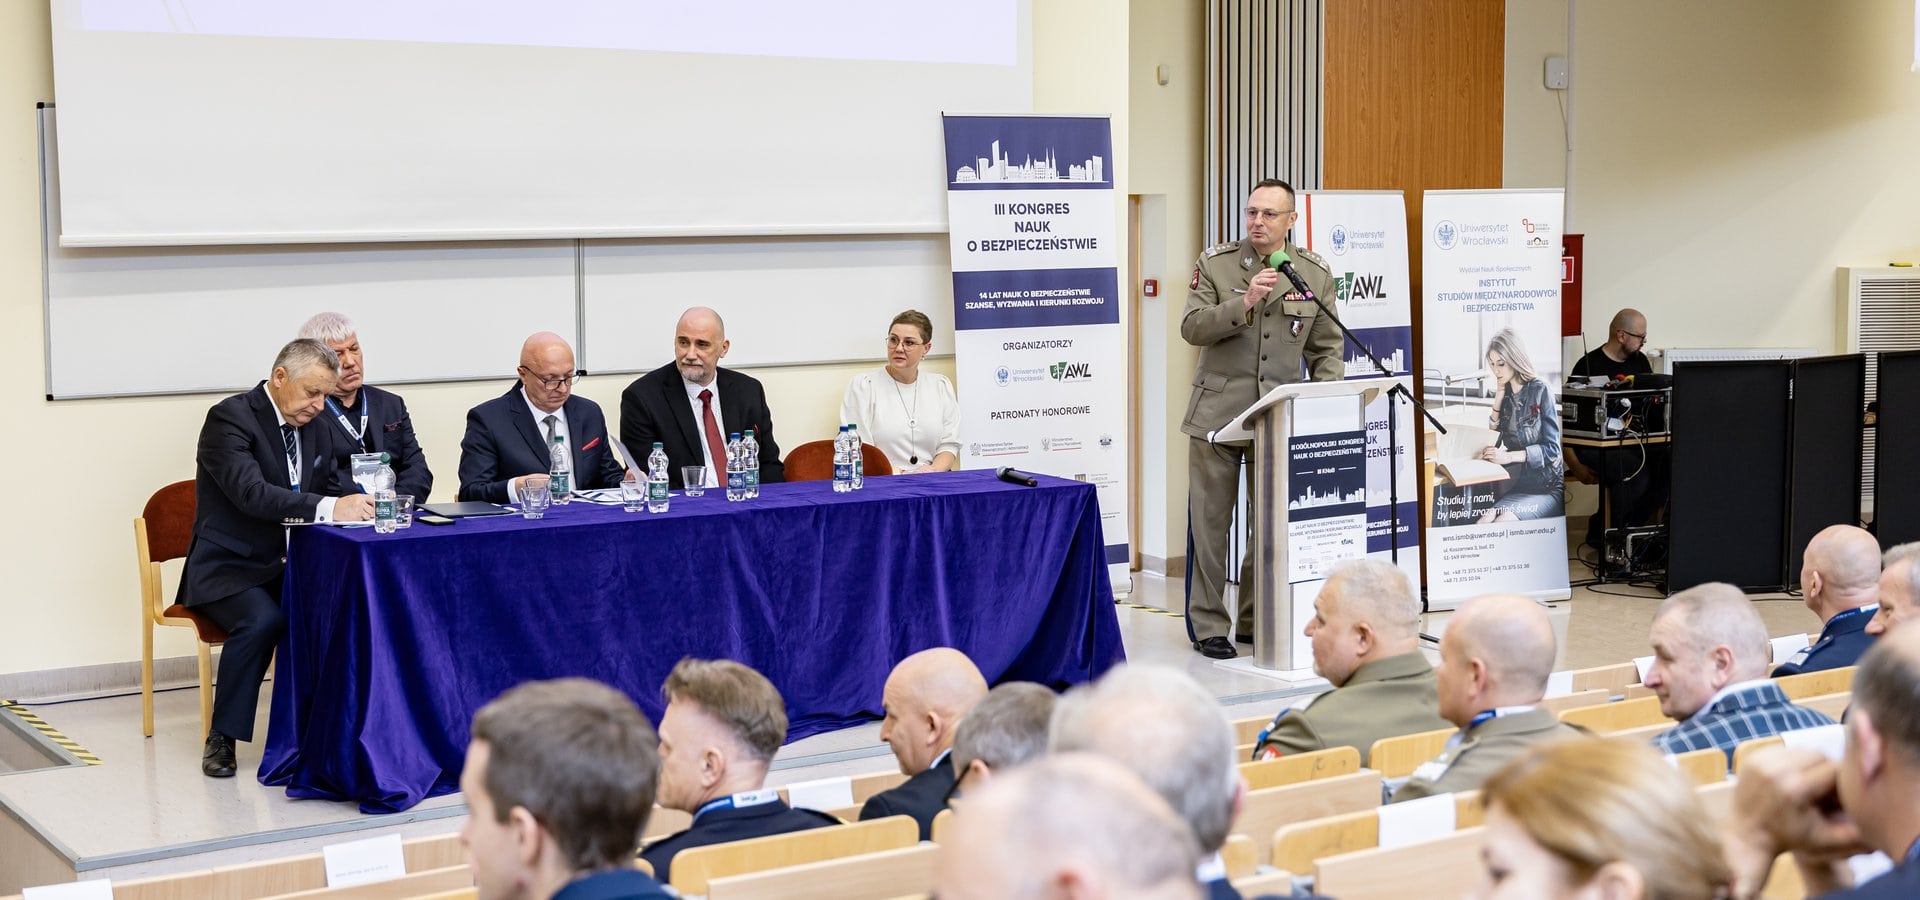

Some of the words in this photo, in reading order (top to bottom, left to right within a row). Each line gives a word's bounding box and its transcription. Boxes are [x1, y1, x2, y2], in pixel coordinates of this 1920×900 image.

[994, 204, 1005, 215] III
[1008, 203, 1070, 215] KONGRES
[1014, 220, 1051, 232] NAUK
[1460, 224, 1509, 233] Uniwersytet
[1350, 230, 1384, 239] Uniwersytet
[967, 240, 977, 252] O
[982, 236, 1097, 252] BEZPIECZEŃSTWIE
[1350, 241, 1384, 249] Wrocławski
[1461, 236, 1508, 245] Wrocławski
[1352, 272, 1386, 300] AWL
[1479, 278, 1516, 287] INSTYTUT
[1031, 288, 1090, 297] BEZPIECZEŃSTWIE
[1438, 292, 1473, 301] STUDIÓW
[1475, 289, 1557, 301] MIĘDZYNARODOWYCH
[965, 301, 995, 310] SZANSE,
[997, 300, 1035, 308] WYZWANIA
[1072, 298, 1104, 306] ROZWOJU
[1467, 301, 1535, 312] BEZPIECZEŃSTWA
[1003, 340, 1073, 350] ORGANIZATORZY
[1064, 362, 1092, 379] AWL
[990, 409, 1040, 420] PATRONATY
[1042, 406, 1090, 416] HONOROWE
[1296, 440, 1337, 450] OGÓLNOPOLSKI
[1366, 435, 1378, 445] UK
[1314, 447, 1363, 458] BEZPIECZEŃSTWIE
[1437, 495, 1466, 506] Studiuj
[1473, 492, 1495, 503] nami,
[1437, 510, 1448, 520] by
[1449, 508, 1471, 519] lepiej
[1516, 503, 1538, 513] świat
[1443, 531, 1505, 542] wns.ismb@uwr.edu.pl
[1509, 527, 1556, 536] ismb.uwr.edu.pl
